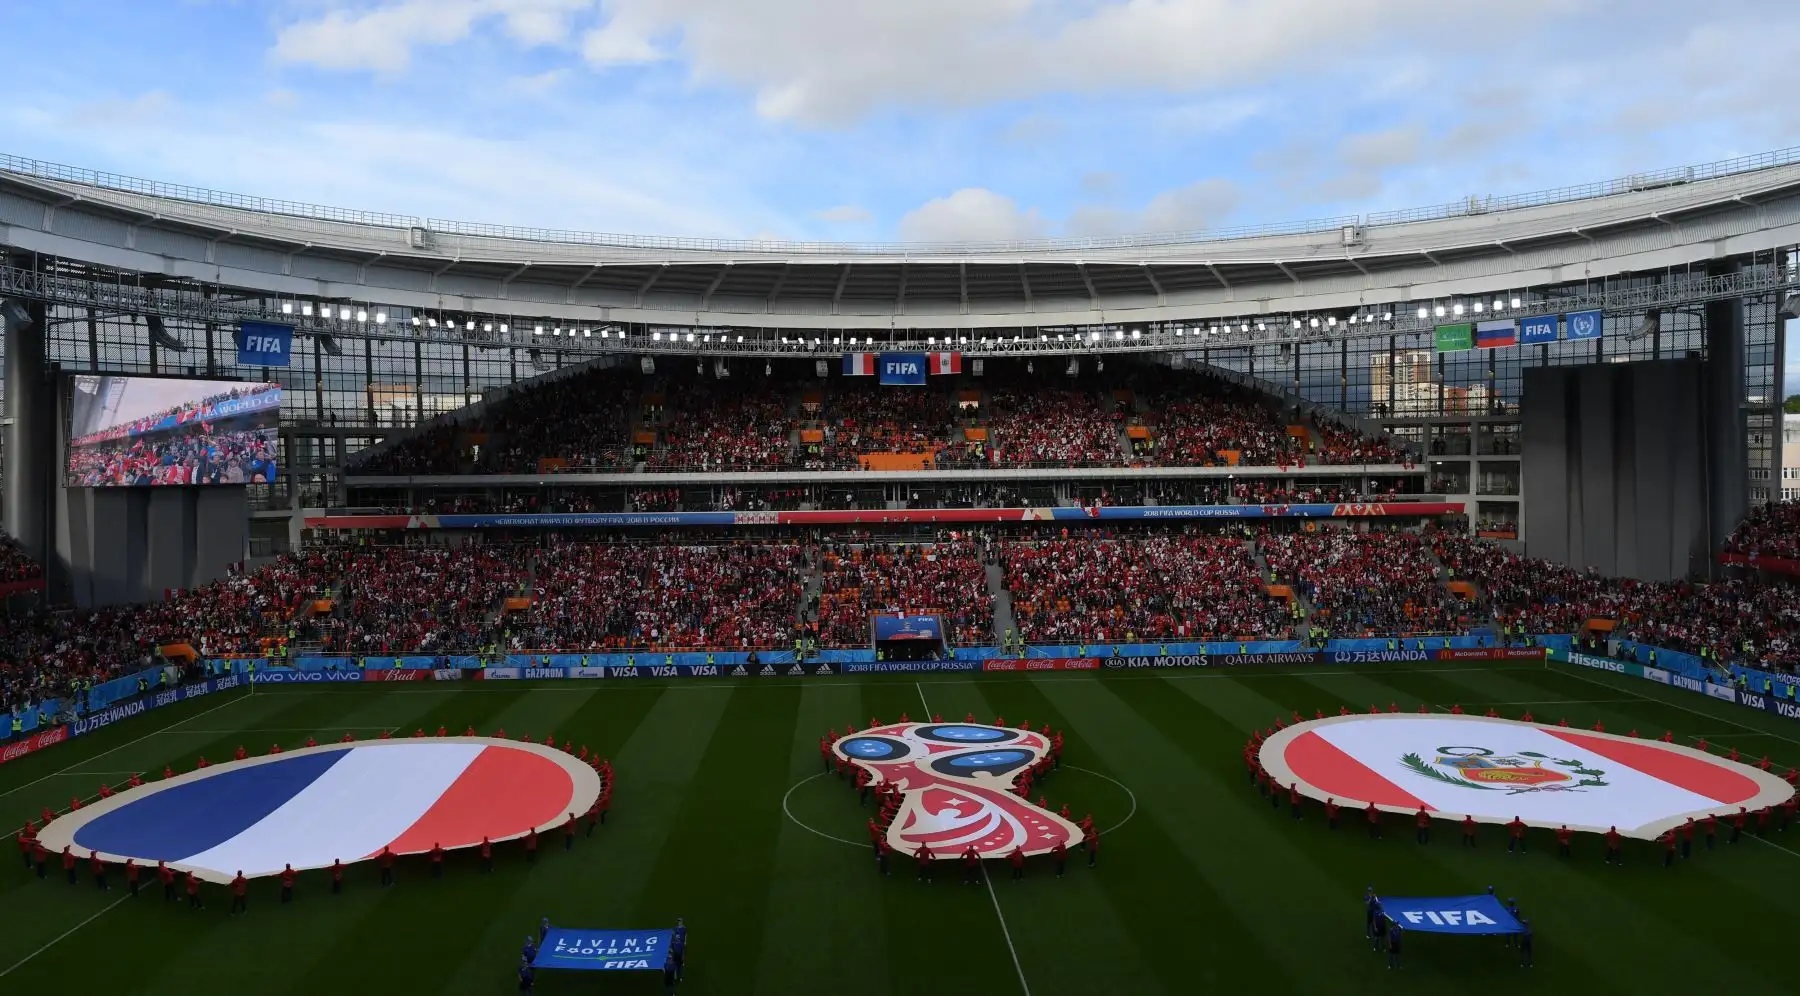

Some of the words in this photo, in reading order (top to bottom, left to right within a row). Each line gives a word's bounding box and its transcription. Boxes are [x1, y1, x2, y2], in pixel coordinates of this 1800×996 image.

[1525, 324, 1552, 336] FIFA
[245, 335, 281, 353] FIFA
[886, 362, 919, 375] FIFA
[219, 399, 262, 415] WORLD
[1127, 657, 1150, 668] KIA
[1153, 655, 1208, 667] MOTORS
[1224, 654, 1264, 666] QATAR
[1265, 653, 1315, 664] AIRWAYS
[1380, 650, 1428, 662] WANDA
[849, 662, 869, 672] 2018
[869, 662, 887, 672] FIFA
[888, 662, 921, 672] WORLD
[922, 662, 940, 671] CUP
[941, 661, 973, 671] RUSSIA
[1567, 652, 1625, 673] Hisense
[382, 669, 417, 681] Bud
[525, 668, 564, 679] GAZPROM
[611, 667, 639, 677] VISA
[650, 666, 678, 677] VISA
[690, 665, 718, 676] VISA
[1673, 675, 1702, 692] GAZPROM
[1740, 691, 1766, 710] VISA
[110, 700, 145, 724] WANDA
[1775, 701, 1800, 719] VISA
[1401, 910, 1498, 926] FIFA
[558, 936, 658, 948] LIVING
[554, 945, 656, 955] FOOTBALL
[603, 959, 649, 969] FIFA
